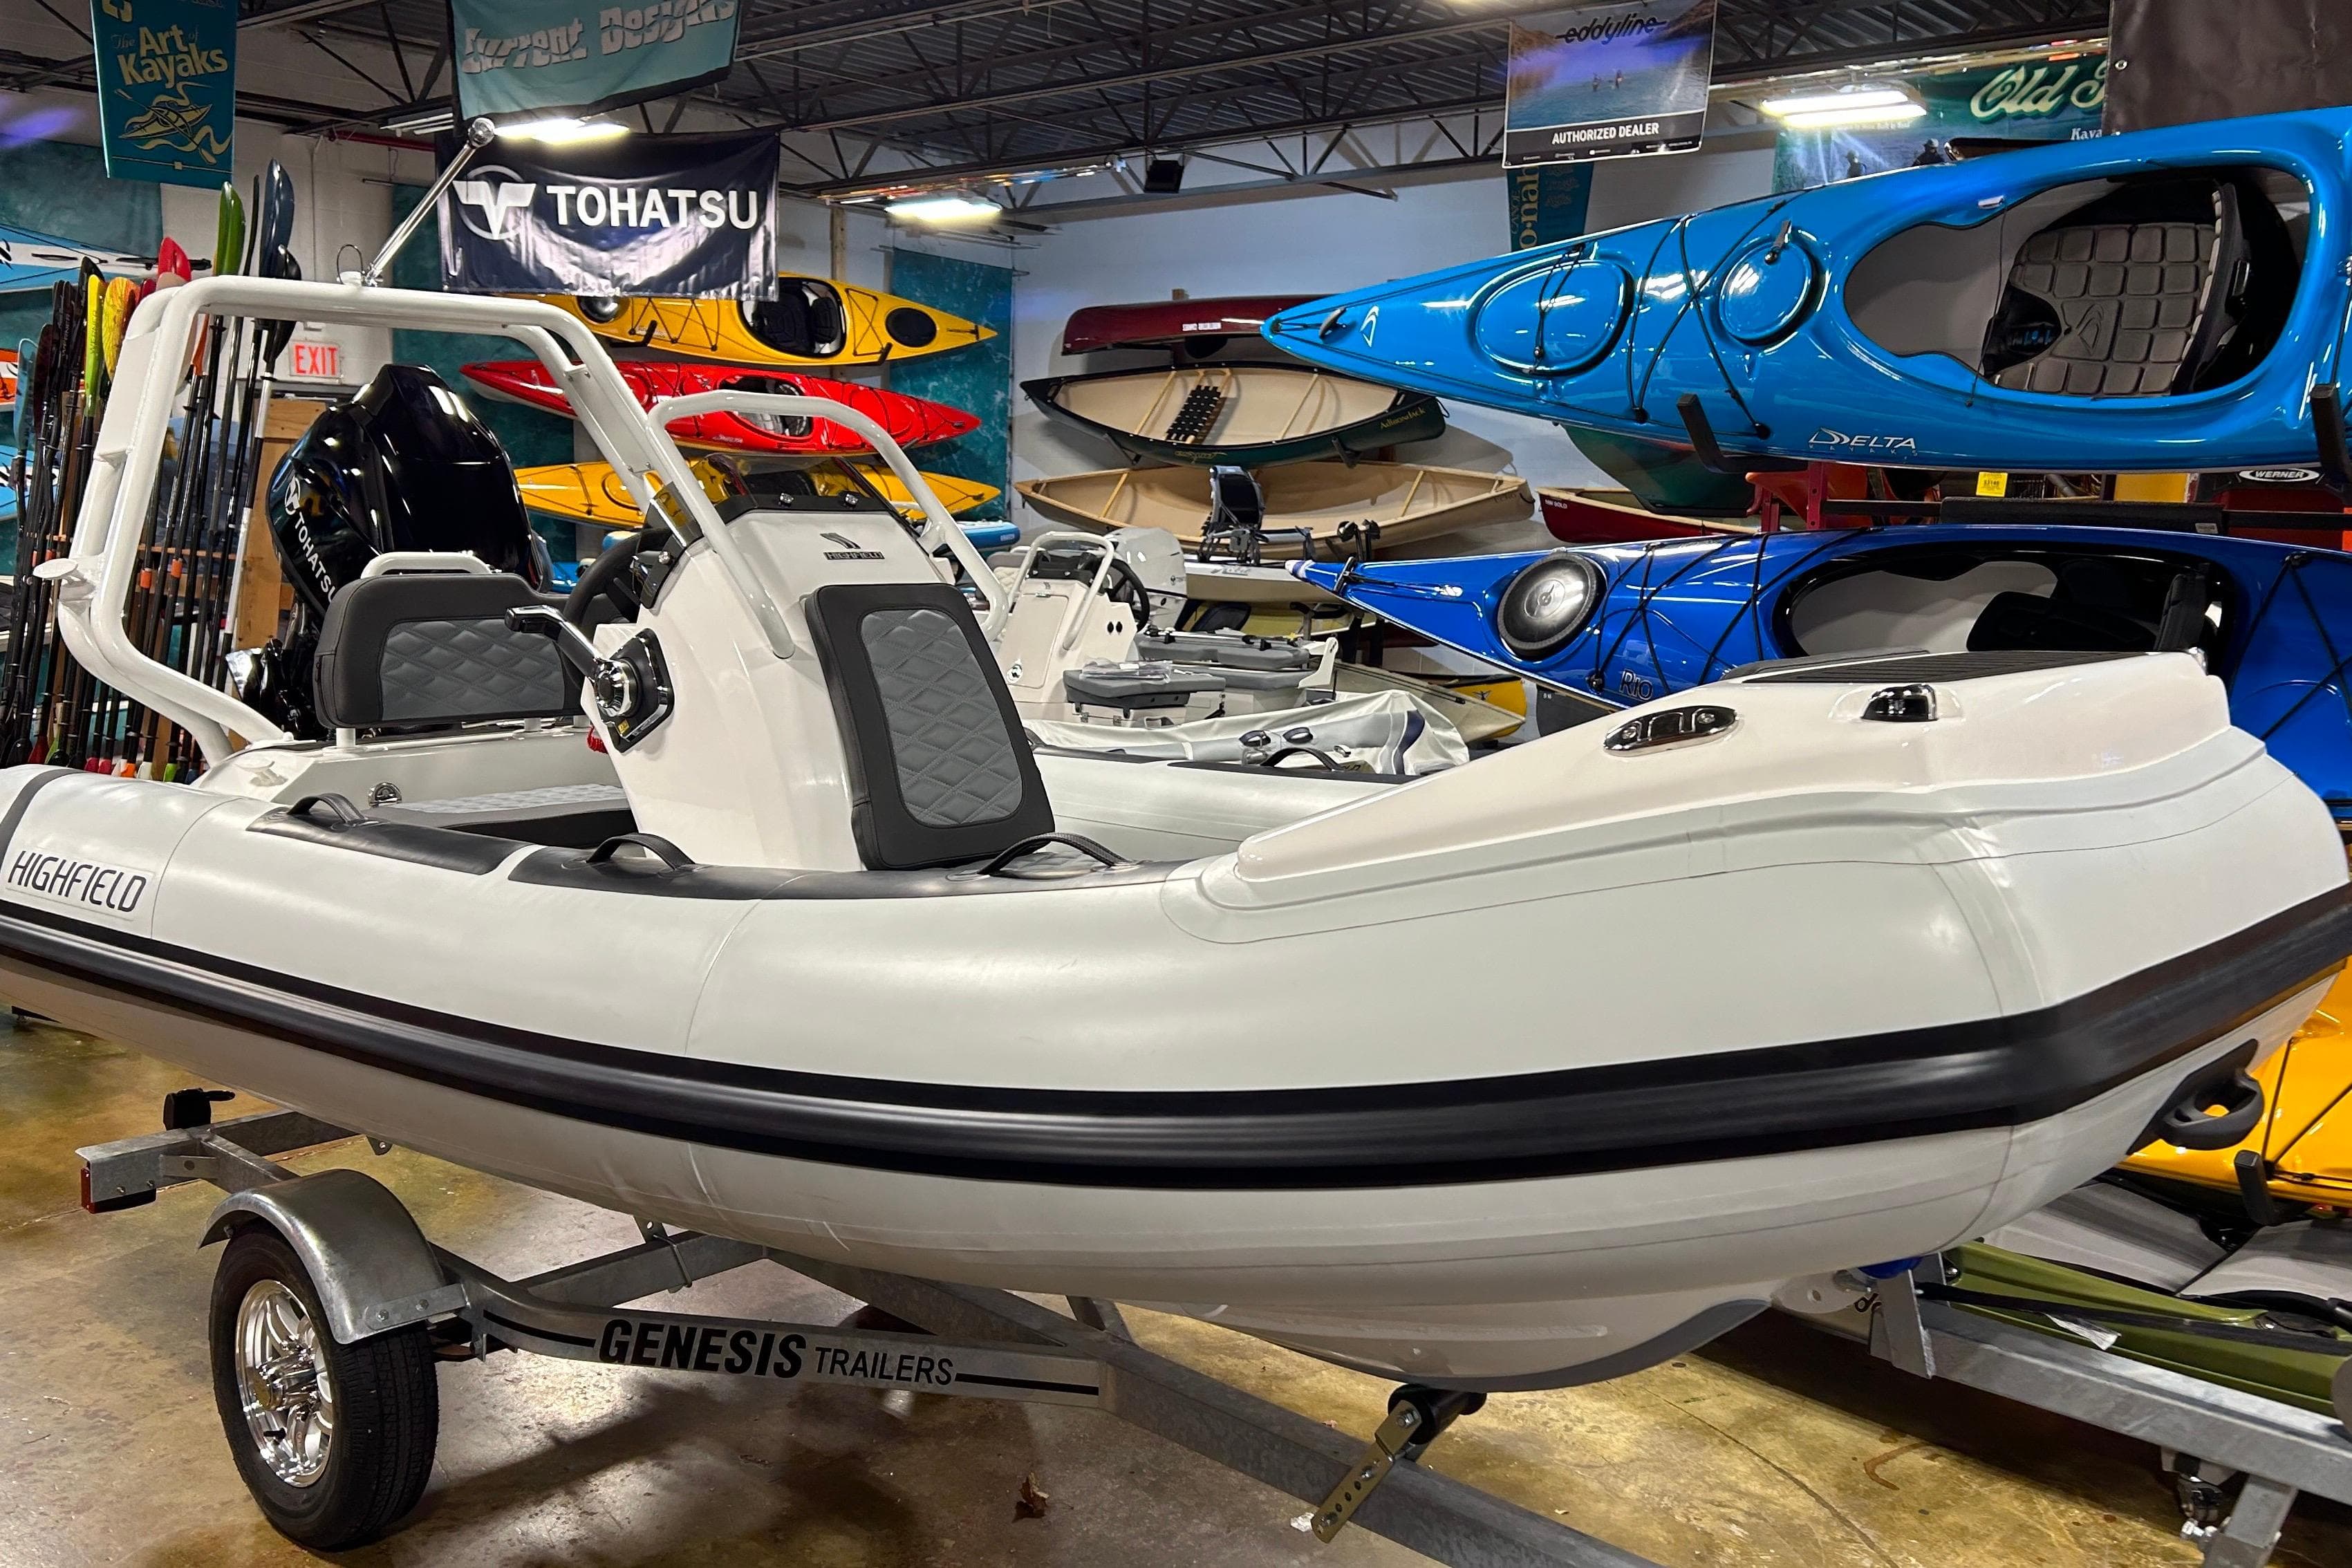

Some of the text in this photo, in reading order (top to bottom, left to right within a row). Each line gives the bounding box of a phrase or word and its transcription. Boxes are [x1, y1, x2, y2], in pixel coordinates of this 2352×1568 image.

[111, 33, 136, 49] The
[139, 24, 189, 57] Art
[463, 18, 588, 74] Current
[1557, 14, 1666, 44] eddyline
[117, 43, 229, 89] Kayaks
[1970, 65, 2080, 118] Old
[1551, 122, 1659, 145] AUTHORIZED DEALER
[546, 185, 758, 230] TOHATSU
[295, 344, 338, 375] EXIT
[1809, 427, 1916, 449] DELTA
[2255, 470, 2305, 479] WERNER
[8, 850, 147, 913] HIGHFIELD
[599, 1318, 954, 1386] GENESIS TRAILERS
